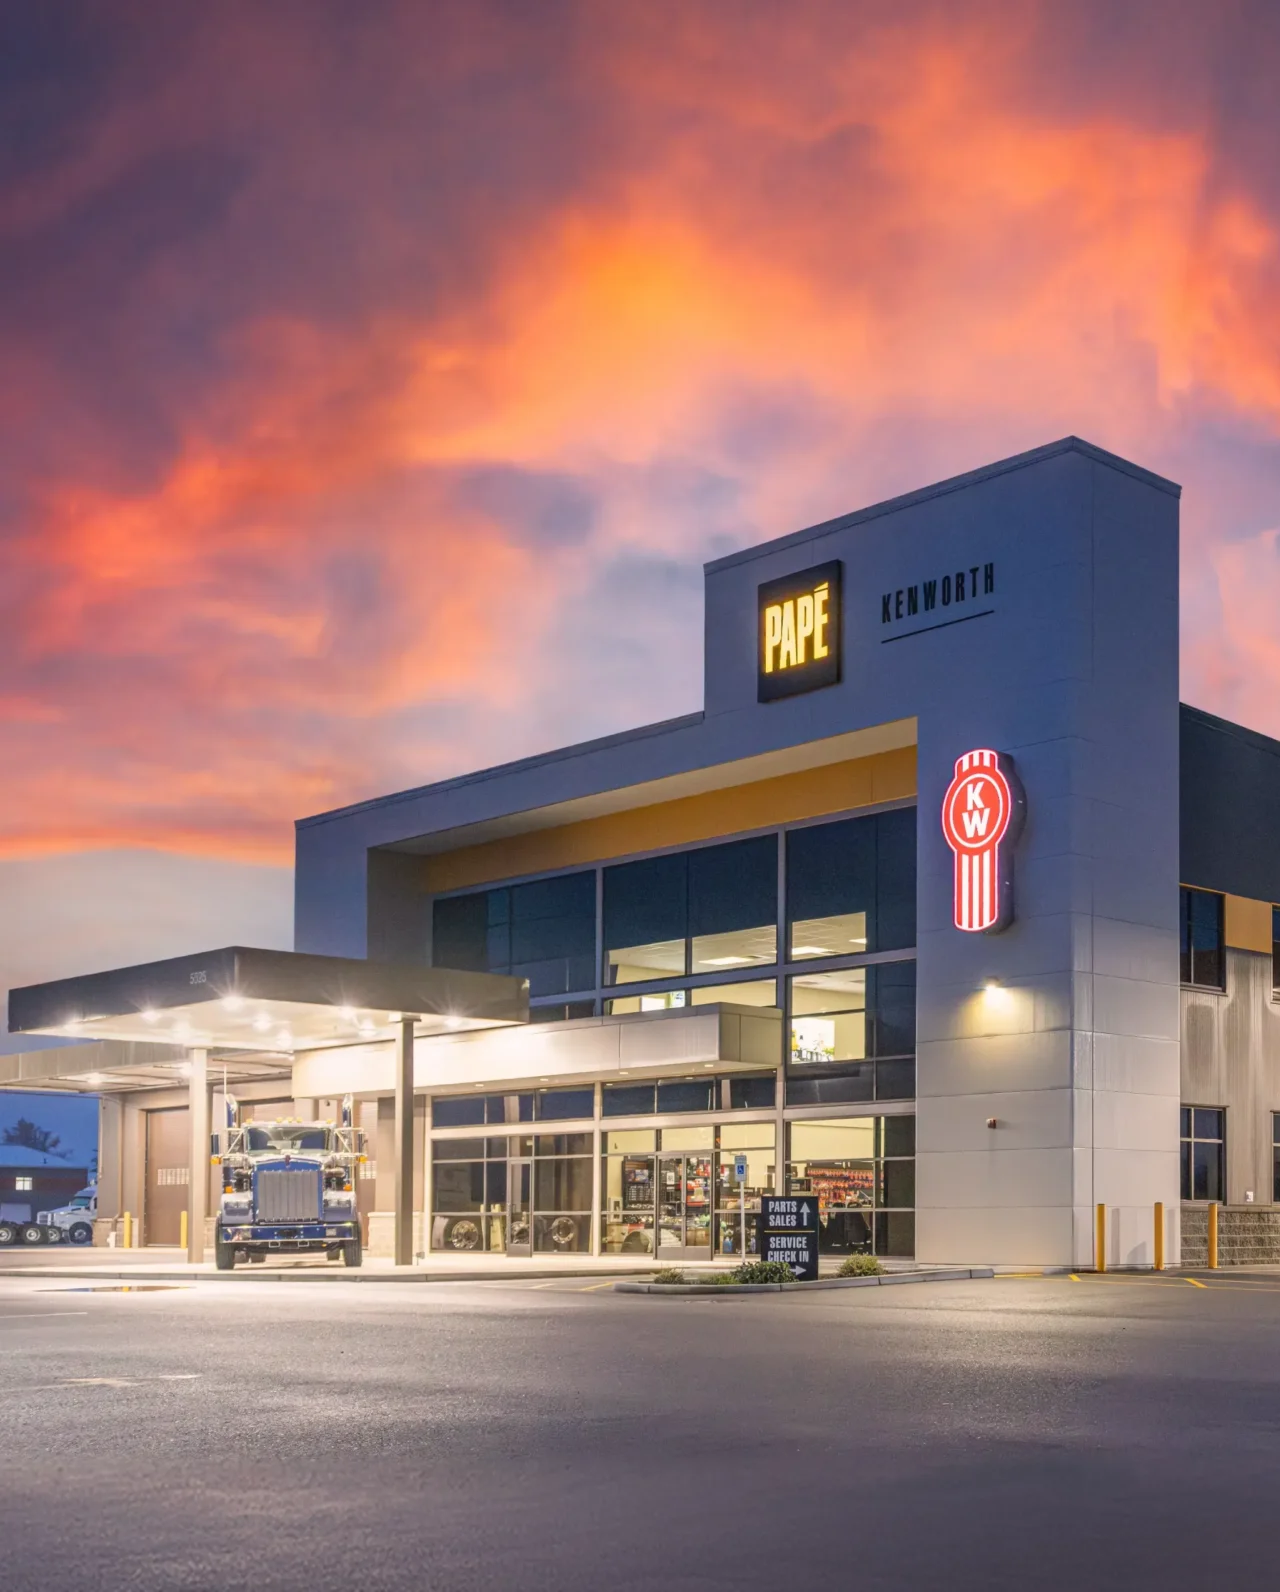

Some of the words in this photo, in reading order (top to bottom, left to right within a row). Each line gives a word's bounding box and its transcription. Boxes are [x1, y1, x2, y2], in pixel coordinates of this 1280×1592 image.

[882, 562, 994, 624] KENWORTH
[765, 581, 829, 674] PAPÉ
[768, 1201, 797, 1213] PARTS
[769, 1214, 797, 1227] SALES
[769, 1236, 807, 1249] SERVICE
[767, 1250, 796, 1262] CHECK
[799, 1250, 809, 1262] IN
